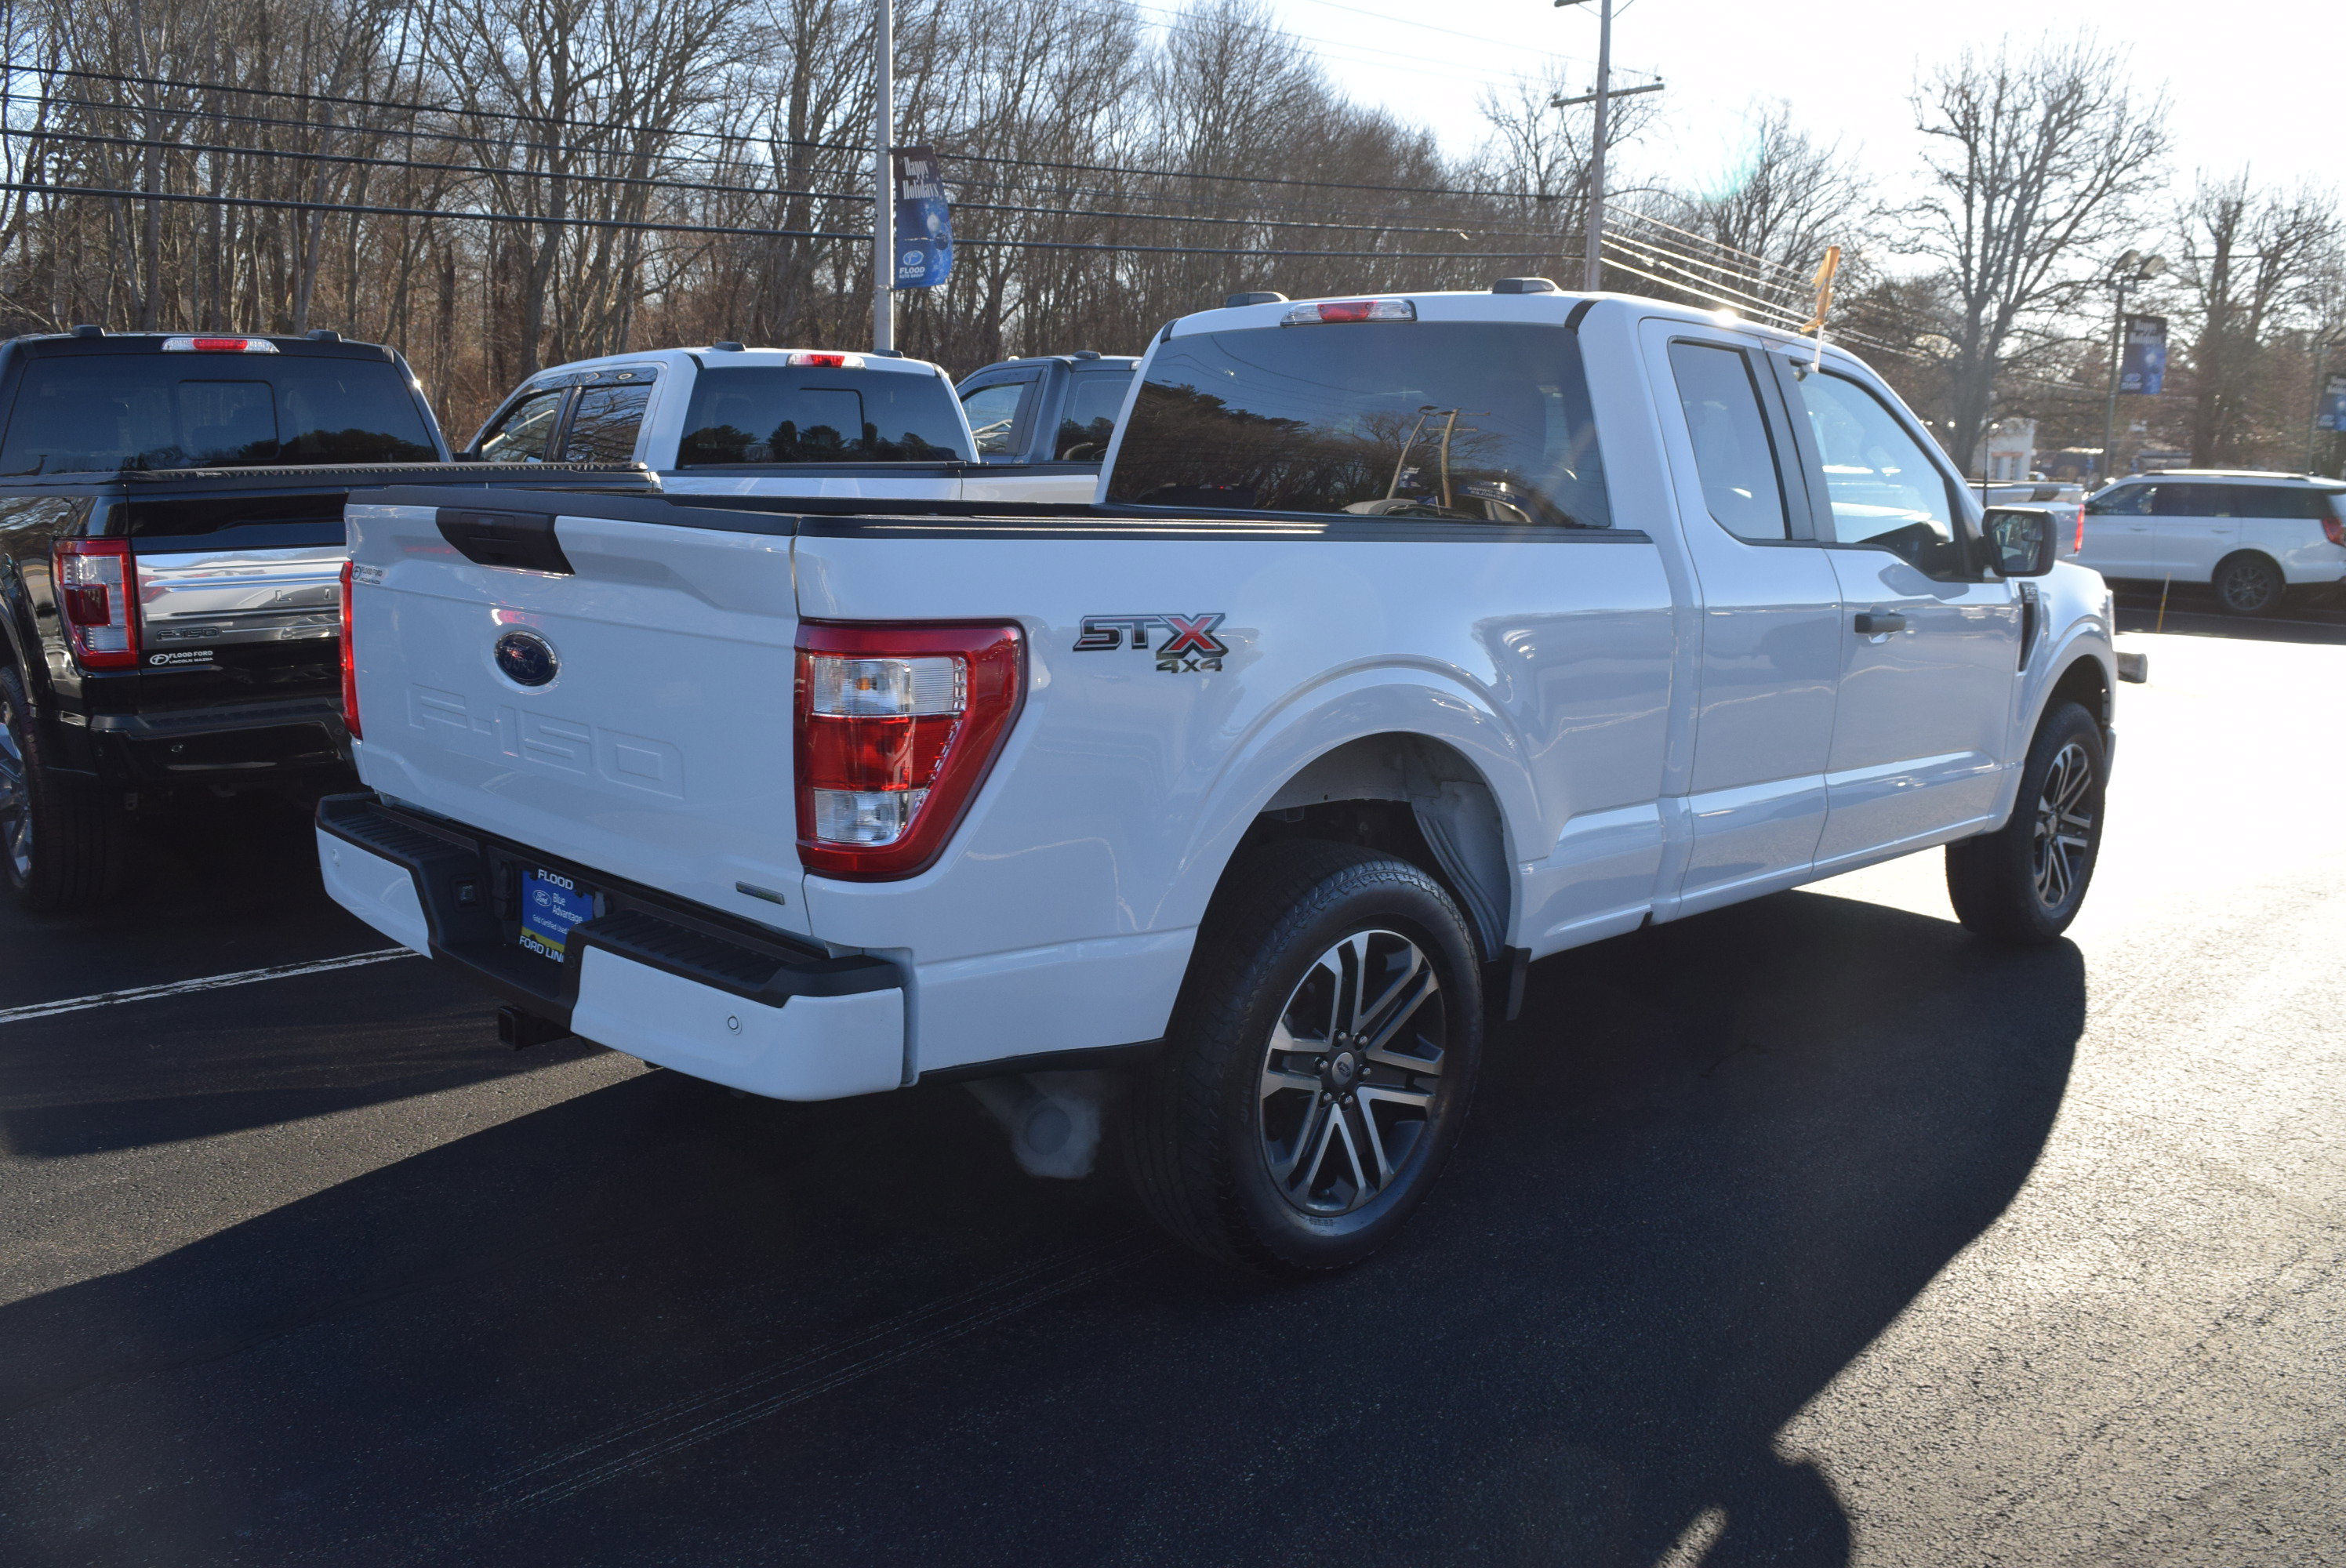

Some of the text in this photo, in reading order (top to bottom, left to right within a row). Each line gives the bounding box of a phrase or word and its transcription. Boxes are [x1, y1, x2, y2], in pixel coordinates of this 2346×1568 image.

[903, 156, 929, 180] Happy
[902, 179, 939, 200] Holidays
[157, 626, 220, 641] F-150
[1073, 613, 1229, 660] STX
[408, 682, 685, 800] F-150
[538, 868, 574, 891] FLOOD
[536, 891, 566, 906] Ford Blue
[552, 904, 583, 924] Advantage
[519, 935, 565, 963] FORD LIN
